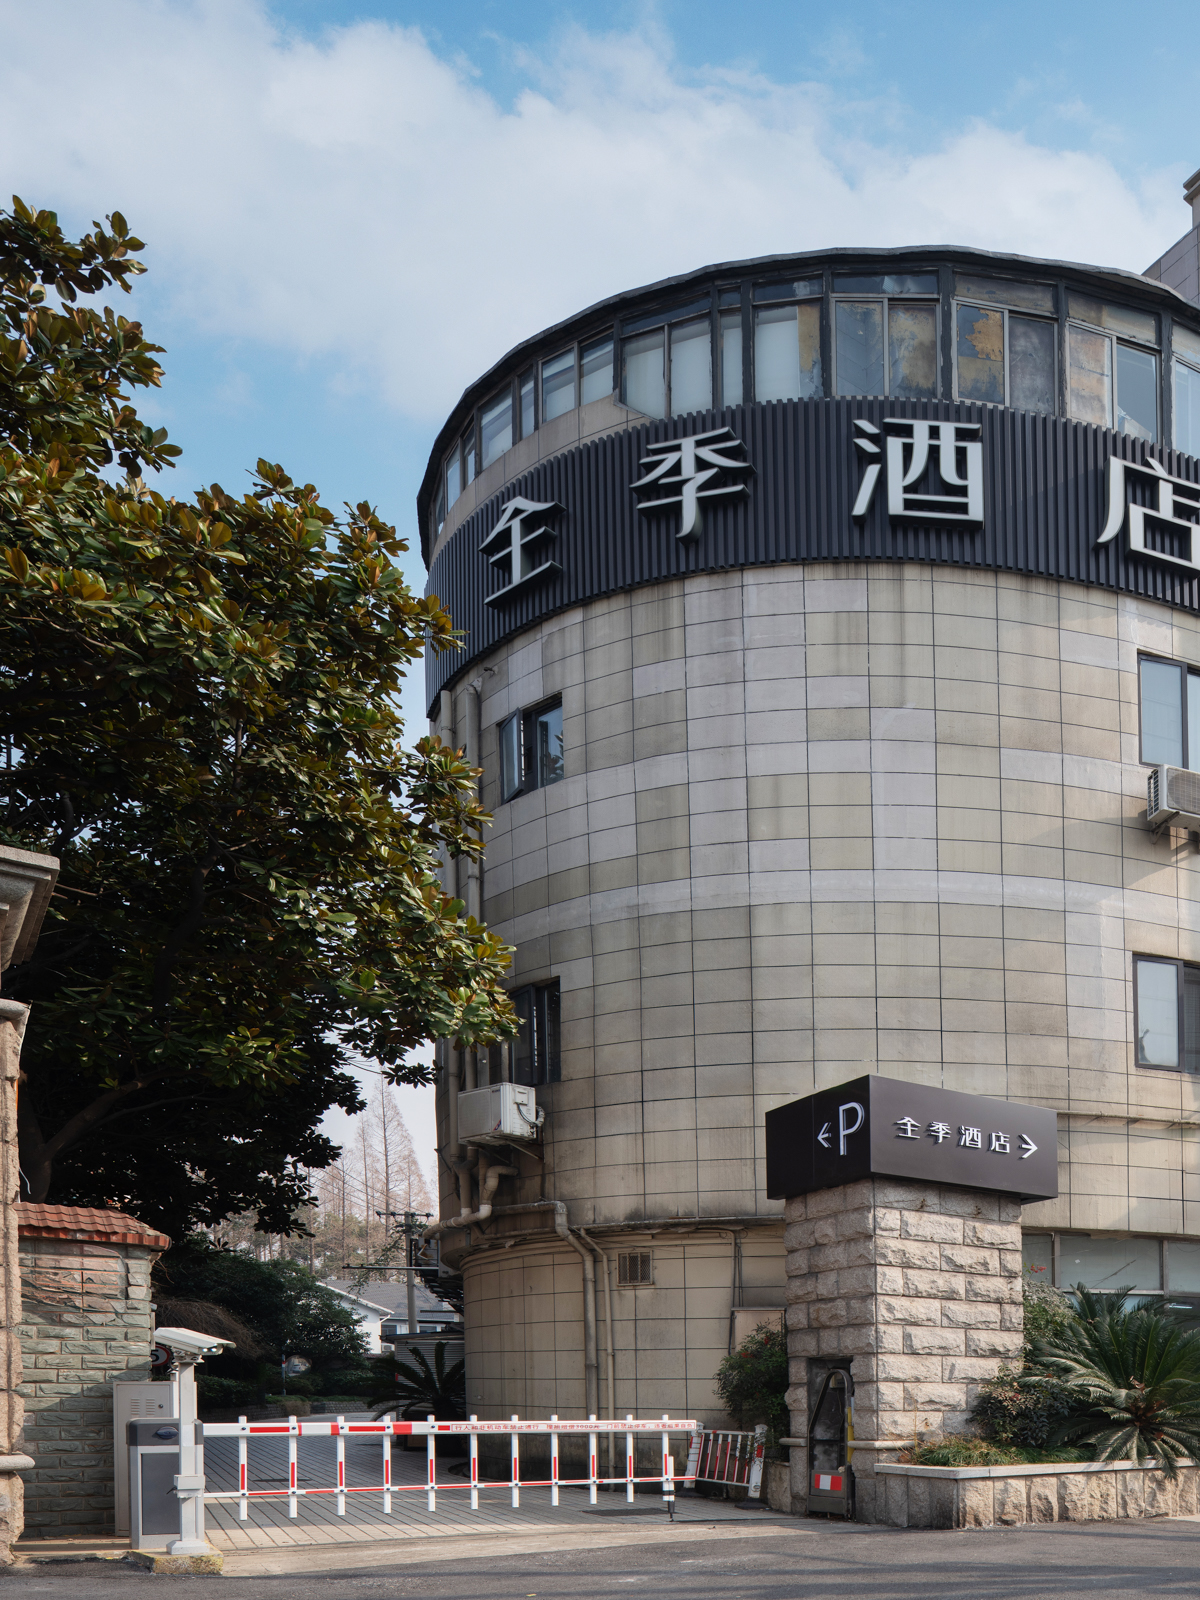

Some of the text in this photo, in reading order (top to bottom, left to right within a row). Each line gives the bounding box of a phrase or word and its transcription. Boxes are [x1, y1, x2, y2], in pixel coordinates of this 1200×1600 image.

[839, 1102, 864, 1156] P
[896, 1116, 1010, 1154] 全季酒店
